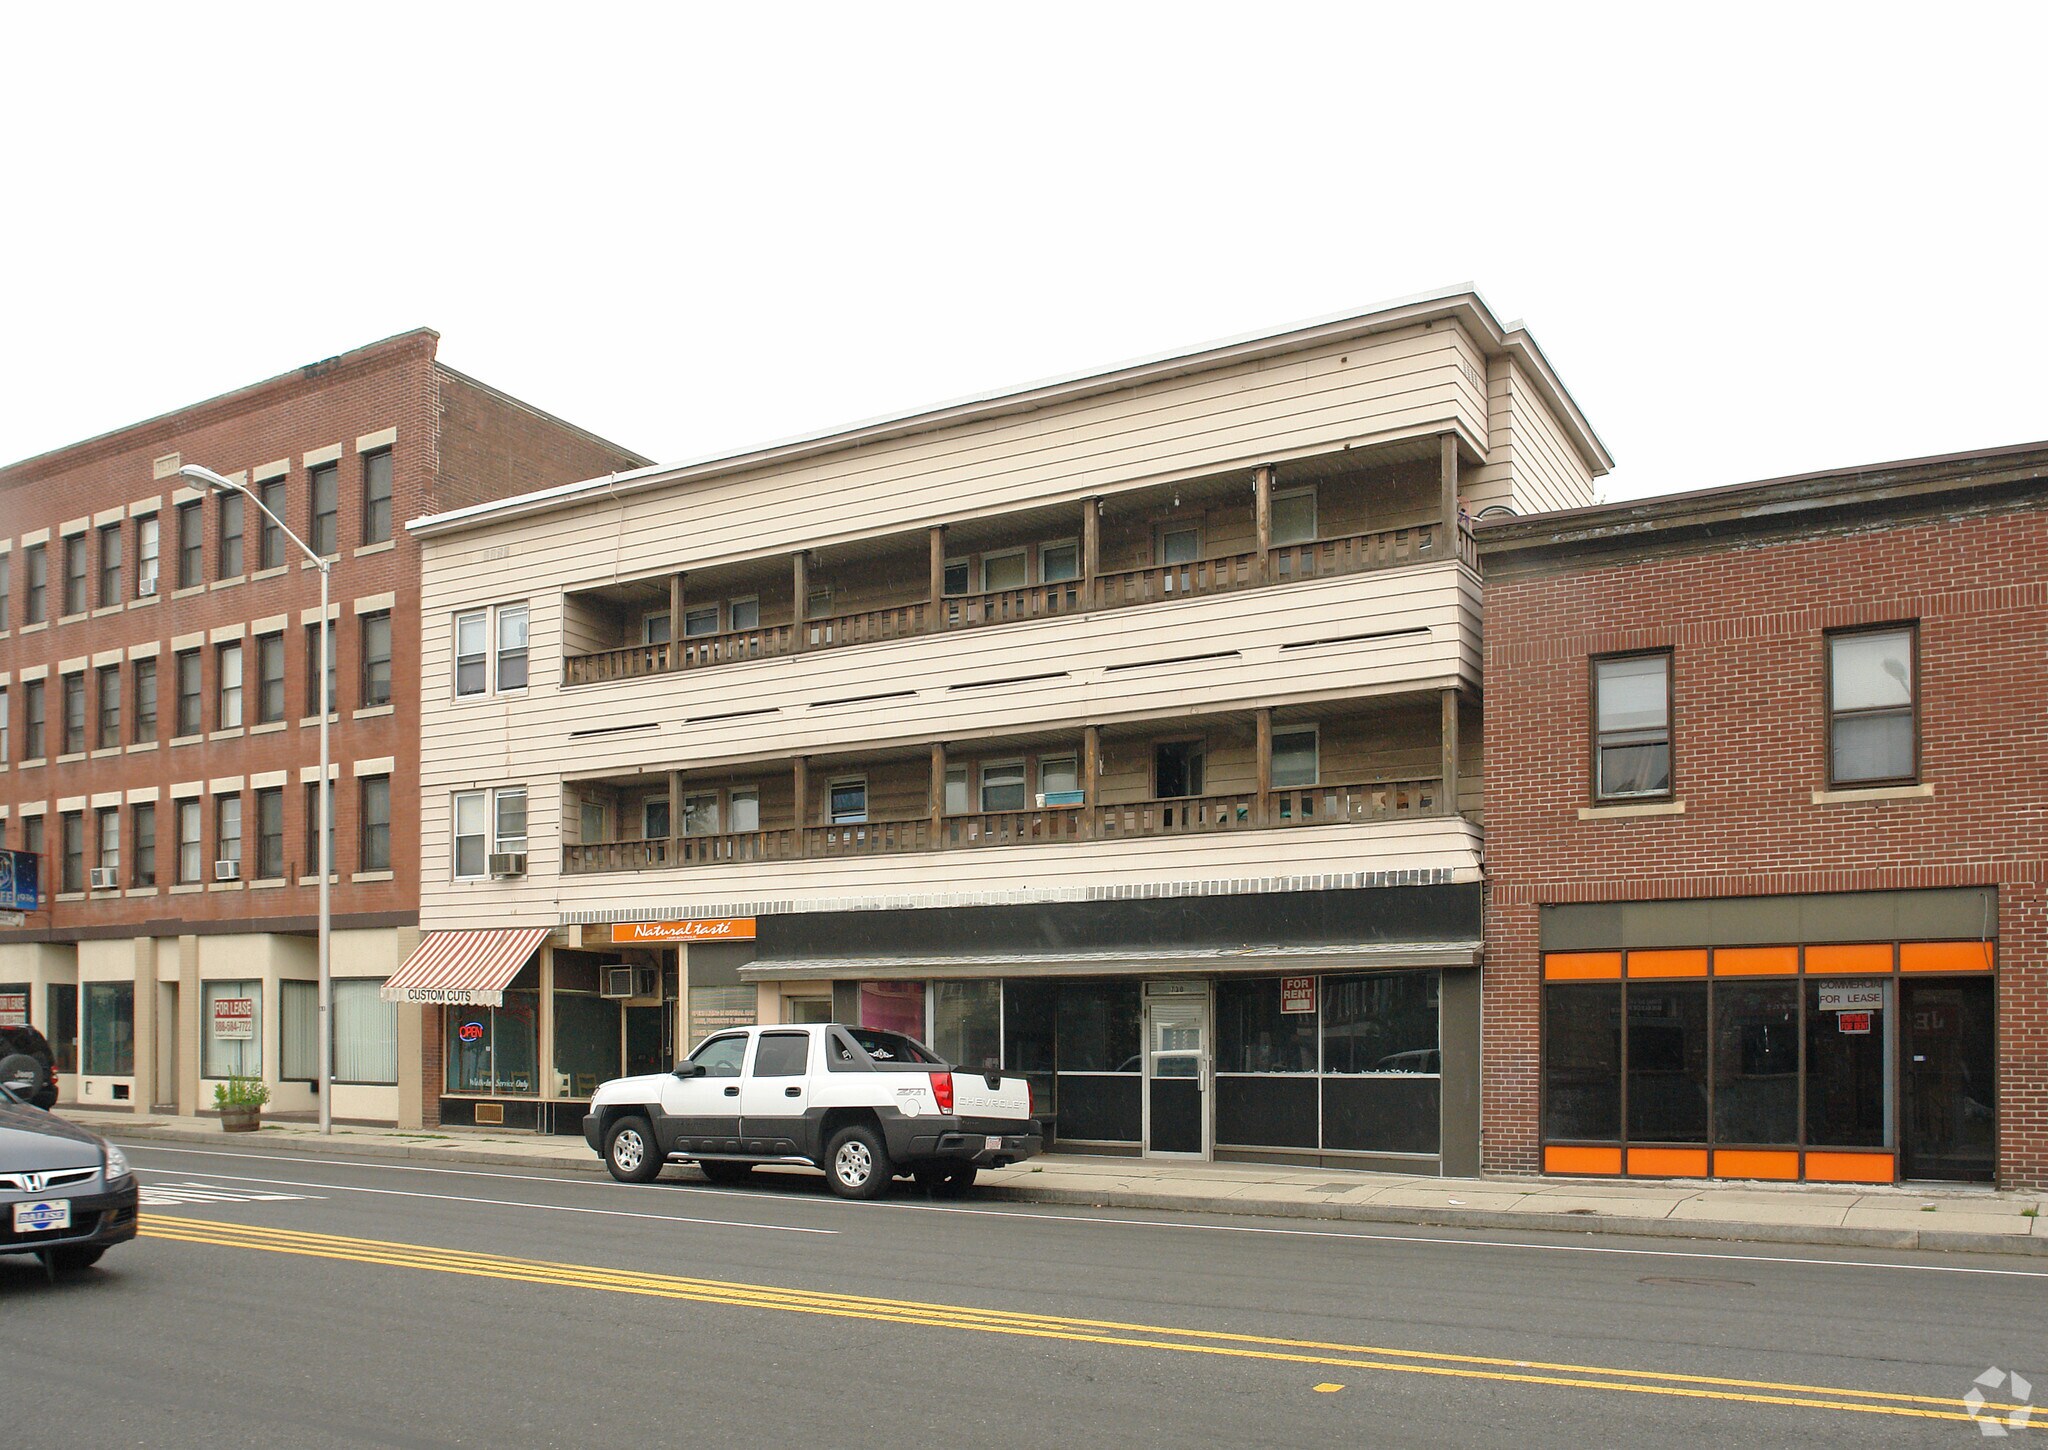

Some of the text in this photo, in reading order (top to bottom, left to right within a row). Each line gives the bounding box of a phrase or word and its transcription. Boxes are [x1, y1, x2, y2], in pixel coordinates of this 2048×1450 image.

[634, 921, 732, 938] Natural tasté
[1286, 980, 1309, 989] FOR
[408, 989, 472, 1001] CUSTOM CUTS
[1283, 989, 1312, 999] RENT
[1820, 993, 1881, 1004] FOR LEASE
[215, 1001, 251, 1015] FOR LEASE
[459, 1025, 483, 1038] OPEN
[1841, 1022, 1868, 1031] FOR RENT
[495, 1078, 514, 1087] Service
[515, 1079, 529, 1091] Only
[959, 1097, 1026, 1110] CHEVROLET
